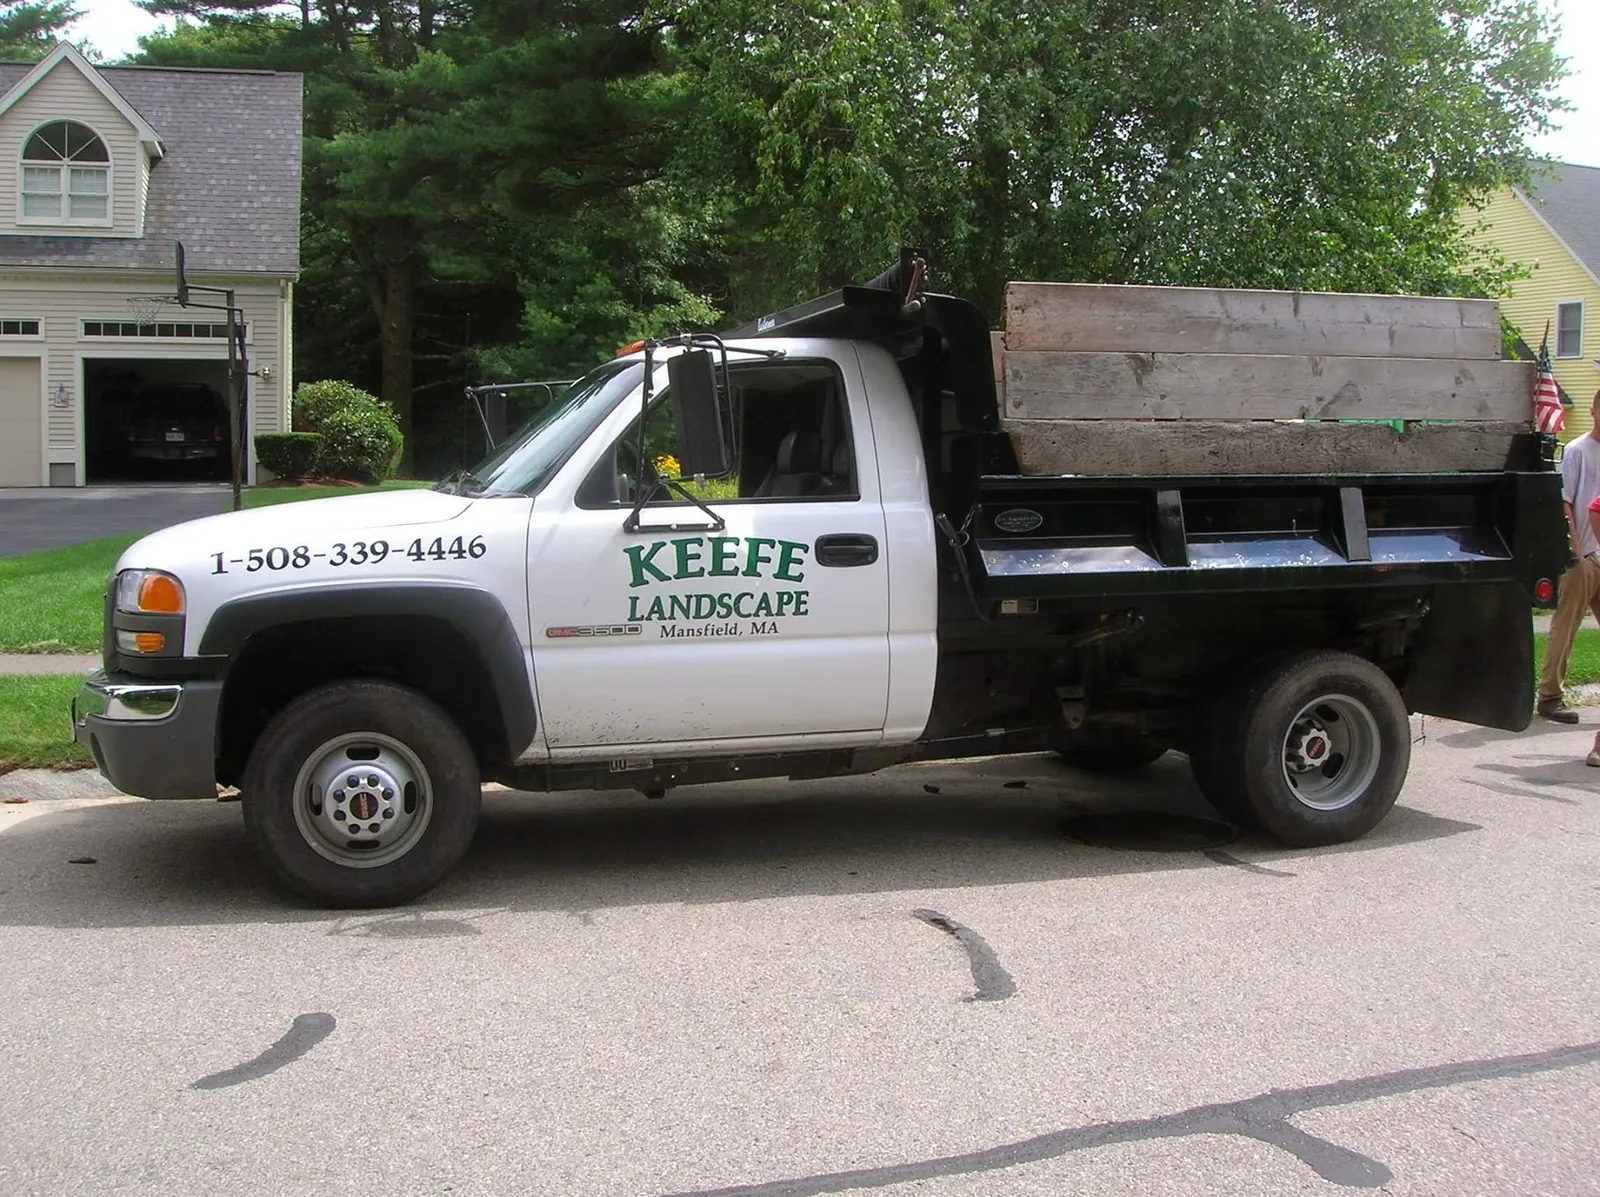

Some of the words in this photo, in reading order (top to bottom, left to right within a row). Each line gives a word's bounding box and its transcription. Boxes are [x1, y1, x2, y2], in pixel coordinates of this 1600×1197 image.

[210, 535, 487, 575] 1-508-339-4446
[623, 537, 809, 588] KEEFE
[627, 590, 809, 622] LANDSCAPE
[659, 624, 744, 639] Mansfield,
[750, 621, 779, 635] MA
